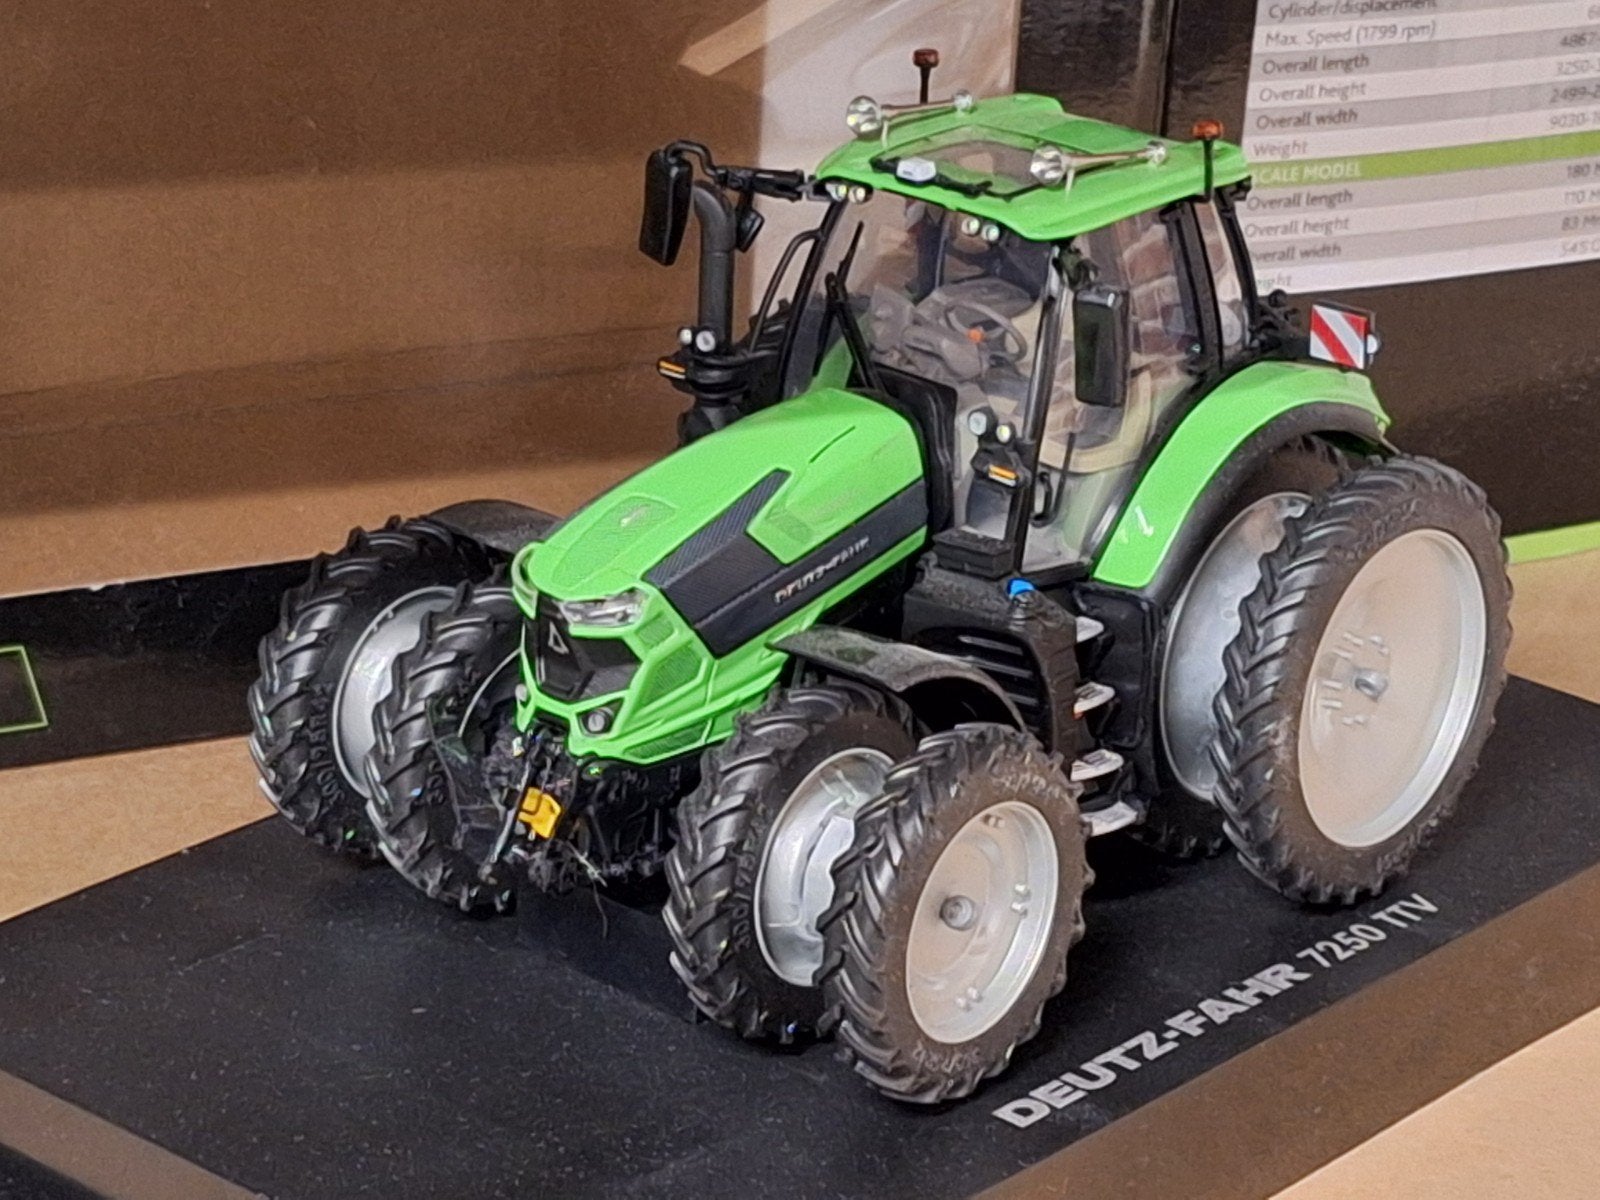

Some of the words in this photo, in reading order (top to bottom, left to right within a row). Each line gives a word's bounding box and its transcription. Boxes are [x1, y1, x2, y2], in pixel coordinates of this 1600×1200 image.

[1306, 29, 1351, 48] Speed
[1262, 57, 1318, 75] Overall
[1321, 54, 1370, 74] length
[1260, 84, 1315, 102] Overall
[1318, 81, 1367, 101] height
[1256, 111, 1311, 130] Overall
[1315, 108, 1358, 126] width
[1252, 139, 1309, 158] Weight
[1303, 161, 1361, 181] MODEL
[1246, 191, 1302, 211] Overall
[1305, 187, 1353, 209] length
[1244, 219, 1299, 238] Overall
[1302, 216, 1350, 236] height
[1249, 246, 1296, 262] verall
[1300, 242, 1342, 259] width
[991, 962, 1313, 1129] DEUTZ-FAHR
[1296, 922, 1388, 969] 7250
[1369, 892, 1440, 929] TTV
